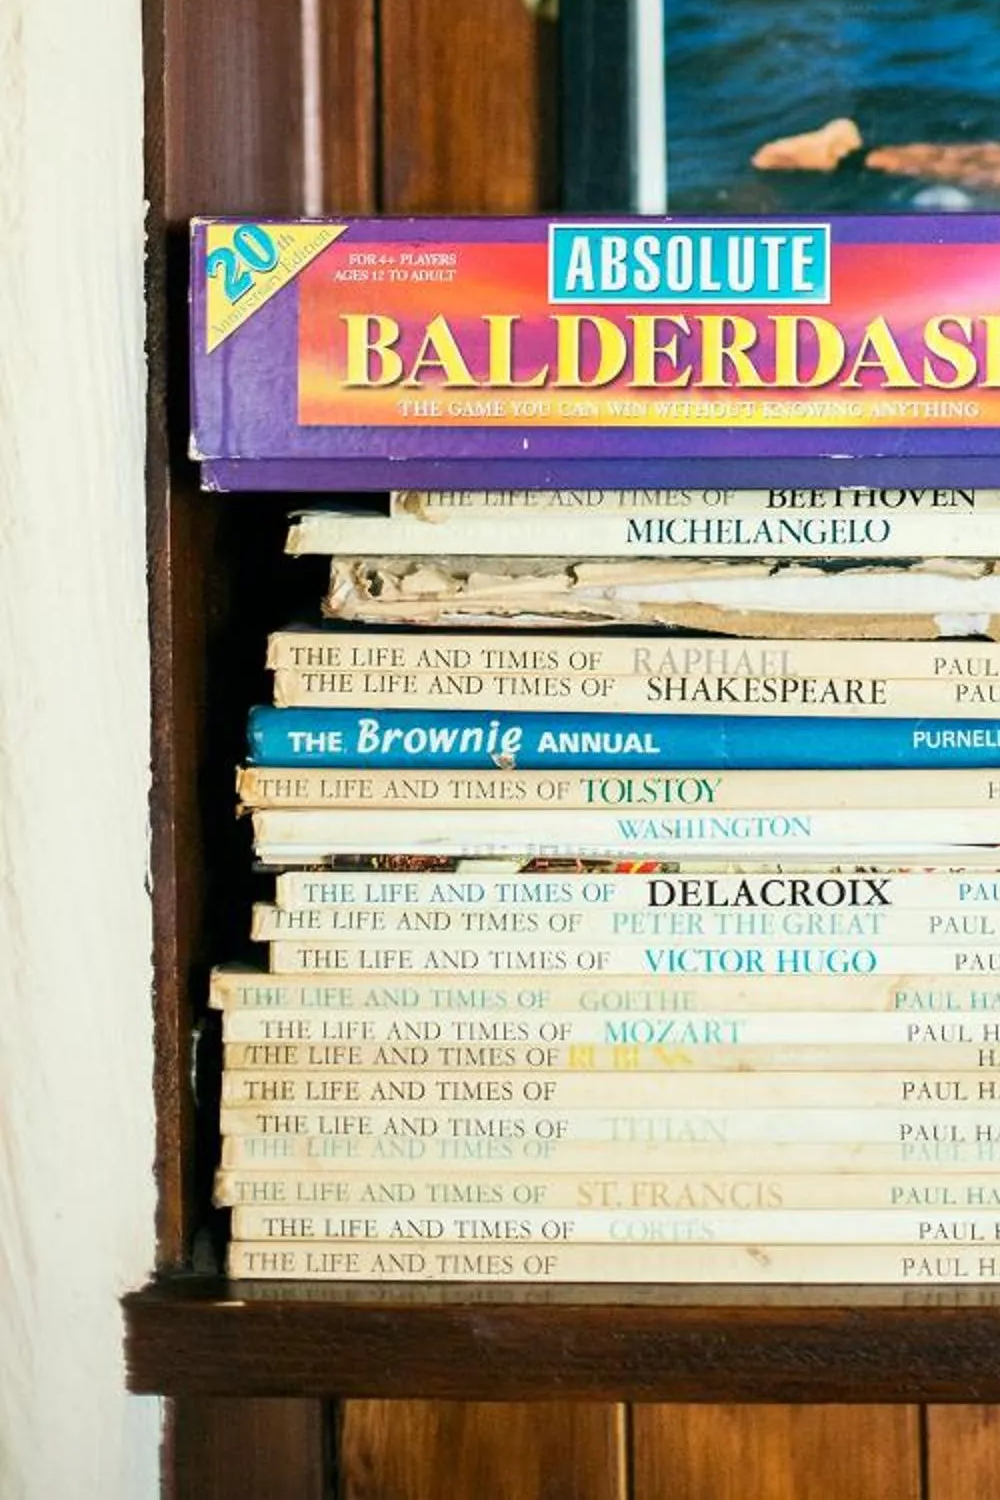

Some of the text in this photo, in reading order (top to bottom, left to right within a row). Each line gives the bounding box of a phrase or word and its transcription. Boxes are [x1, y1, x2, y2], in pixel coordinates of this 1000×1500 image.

[349, 253, 376, 265] FOR
[400, 253, 457, 266] PLAYERS
[565, 235, 813, 291] ABSOLUTE
[334, 270, 369, 281] AGES
[388, 270, 408, 281] TO
[411, 269, 457, 282] ADULT
[400, 400, 979, 418] THE GAME YOU CAN WIN WITHOUT KNOWING ANYTHING
[426, 489, 474, 507] THE
[485, 489, 539, 507] LIFE
[550, 489, 603, 507] AND
[617, 489, 691, 507] TIMES
[702, 489, 736, 507] OF
[766, 488, 976, 509] BEETHOVEN
[626, 517, 891, 544] MICHELANGELO
[290, 646, 342, 667] THE
[351, 647, 405, 668] LIFE
[416, 649, 471, 669] AND
[481, 650, 560, 671] TIMES
[568, 651, 604, 671] OF
[633, 648, 797, 677] RAPHAEL
[933, 657, 998, 677] PAUL
[302, 673, 353, 694] THE
[363, 674, 418, 695] LIFE
[428, 675, 483, 696] AND
[493, 676, 572, 697] TIMES
[581, 677, 616, 698] OF
[646, 677, 887, 705] SHAKESPEARE
[288, 731, 342, 753] THE
[357, 718, 524, 754] Brownie
[537, 731, 660, 753] ANNUAL
[258, 778, 309, 799] THE
[320, 779, 373, 799] LIFE
[383, 779, 438, 800] AND
[448, 780, 526, 800] TIMES
[537, 780, 571, 800] OF
[580, 778, 720, 804] TOLSTOY
[616, 817, 812, 841] WASHINGTON
[304, 883, 355, 904] THE
[365, 883, 419, 903] LIFE
[430, 883, 485, 903] AND
[494, 883, 573, 903] TIMES
[582, 883, 616, 903] OF
[647, 878, 893, 908] DELACROIX
[272, 908, 321, 930] THE
[332, 910, 385, 931] LIFE
[397, 911, 451, 931] AND
[461, 912, 540, 932] TIMES
[549, 912, 583, 933] OF
[612, 912, 704, 935] PETER
[714, 912, 776, 935] THE
[782, 912, 887, 936] GREAT
[929, 915, 994, 935] PAUL
[297, 948, 349, 969] THE
[359, 949, 413, 970] LIFE
[424, 950, 479, 971] AND
[489, 950, 567, 971] TIMES
[577, 950, 611, 971] OF
[644, 948, 764, 973] VICTOR
[776, 948, 878, 973] HUGO
[238, 986, 288, 1007] THE
[300, 987, 353, 1007] LIFE
[364, 988, 419, 1007] AND
[430, 988, 509, 1008] TIMES
[517, 989, 551, 1009] OF
[579, 988, 699, 1012] GOETHE
[895, 990, 960, 1010] PAUL
[260, 1019, 311, 1039] THE
[322, 1020, 375, 1041] LIFE
[386, 1021, 441, 1042] AND
[451, 1021, 530, 1042] TIMES
[539, 1021, 573, 1042] OF
[604, 1017, 747, 1044] MOZART
[907, 1023, 972, 1043] PAUL
[246, 1045, 298, 1065] THE
[308, 1046, 361, 1066] LIFE
[372, 1046, 428, 1066] AND
[438, 1046, 516, 1067] TIMES
[525, 1047, 560, 1067] OF
[244, 1081, 295, 1101] THE
[306, 1081, 360, 1102] LIFE
[371, 1081, 425, 1102] AND
[435, 1081, 514, 1102] TIMES
[523, 1081, 557, 1102] OF
[902, 1082, 968, 1102] PAUL
[257, 1114, 308, 1134] THE
[318, 1115, 373, 1135] LIFE
[383, 1116, 438, 1137] AND
[448, 1118, 526, 1139] TIMES
[535, 1119, 569, 1140] OF
[899, 1123, 965, 1143] PAUL
[235, 1181, 286, 1201] THE
[296, 1182, 350, 1203] LIFE
[361, 1183, 416, 1204] AND
[426, 1184, 504, 1204] TIMES
[513, 1184, 548, 1205] OF
[631, 1181, 784, 1209] FRANCIS
[890, 1186, 957, 1206] PAUL
[263, 1217, 314, 1238] THE
[325, 1218, 377, 1239] LIFE
[388, 1219, 444, 1239] AND
[454, 1219, 532, 1240] TIMES
[541, 1220, 575, 1241] OF
[919, 1222, 985, 1241] PAUL
[245, 1251, 296, 1272] THE
[306, 1252, 361, 1273] LIFE
[370, 1253, 426, 1274] AND
[437, 1254, 515, 1275] TIMES
[524, 1255, 558, 1276] OF
[902, 1256, 968, 1277] PAUL
